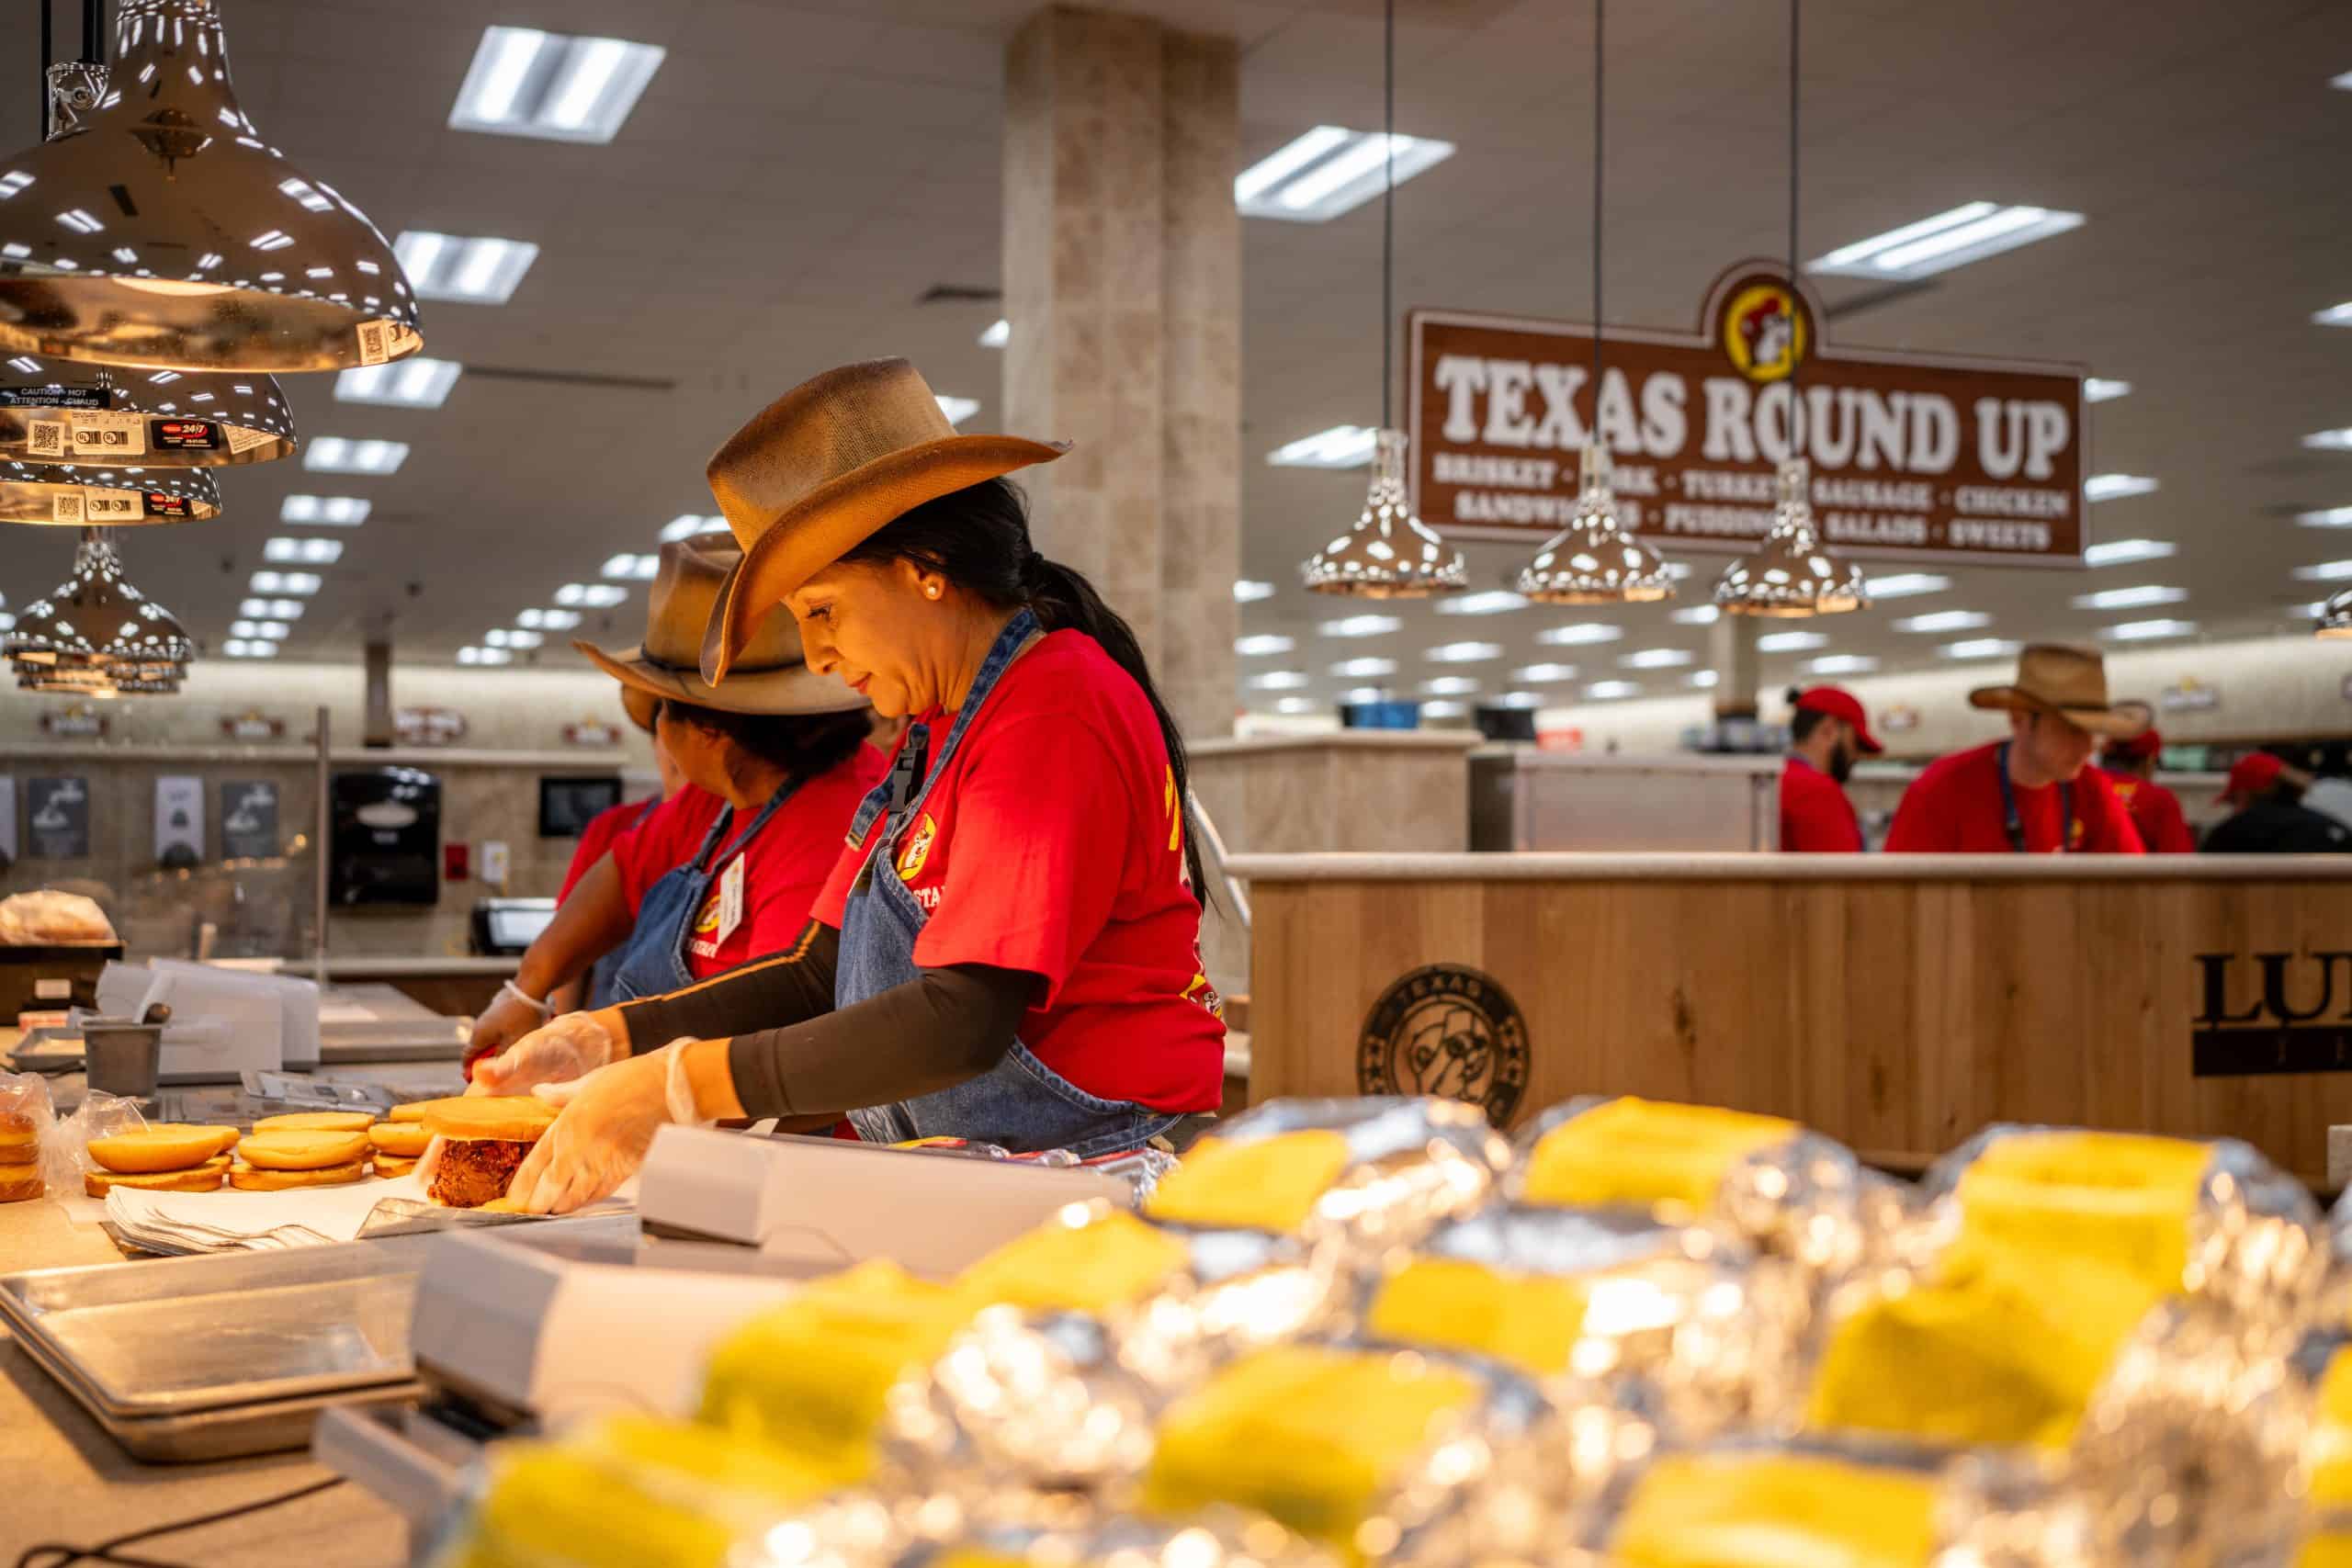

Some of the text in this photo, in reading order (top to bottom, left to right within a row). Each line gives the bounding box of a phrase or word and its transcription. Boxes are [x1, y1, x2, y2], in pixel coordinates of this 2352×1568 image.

[10, 396, 60, 405] ATTENTION
[21, 387, 60, 396] CAUTION
[68, 389, 87, 397] HOT
[1434, 355, 2071, 480] TEXAS ROUND UP
[1433, 453, 1557, 489] BRISKET
[2190, 950, 2352, 1023] LU
